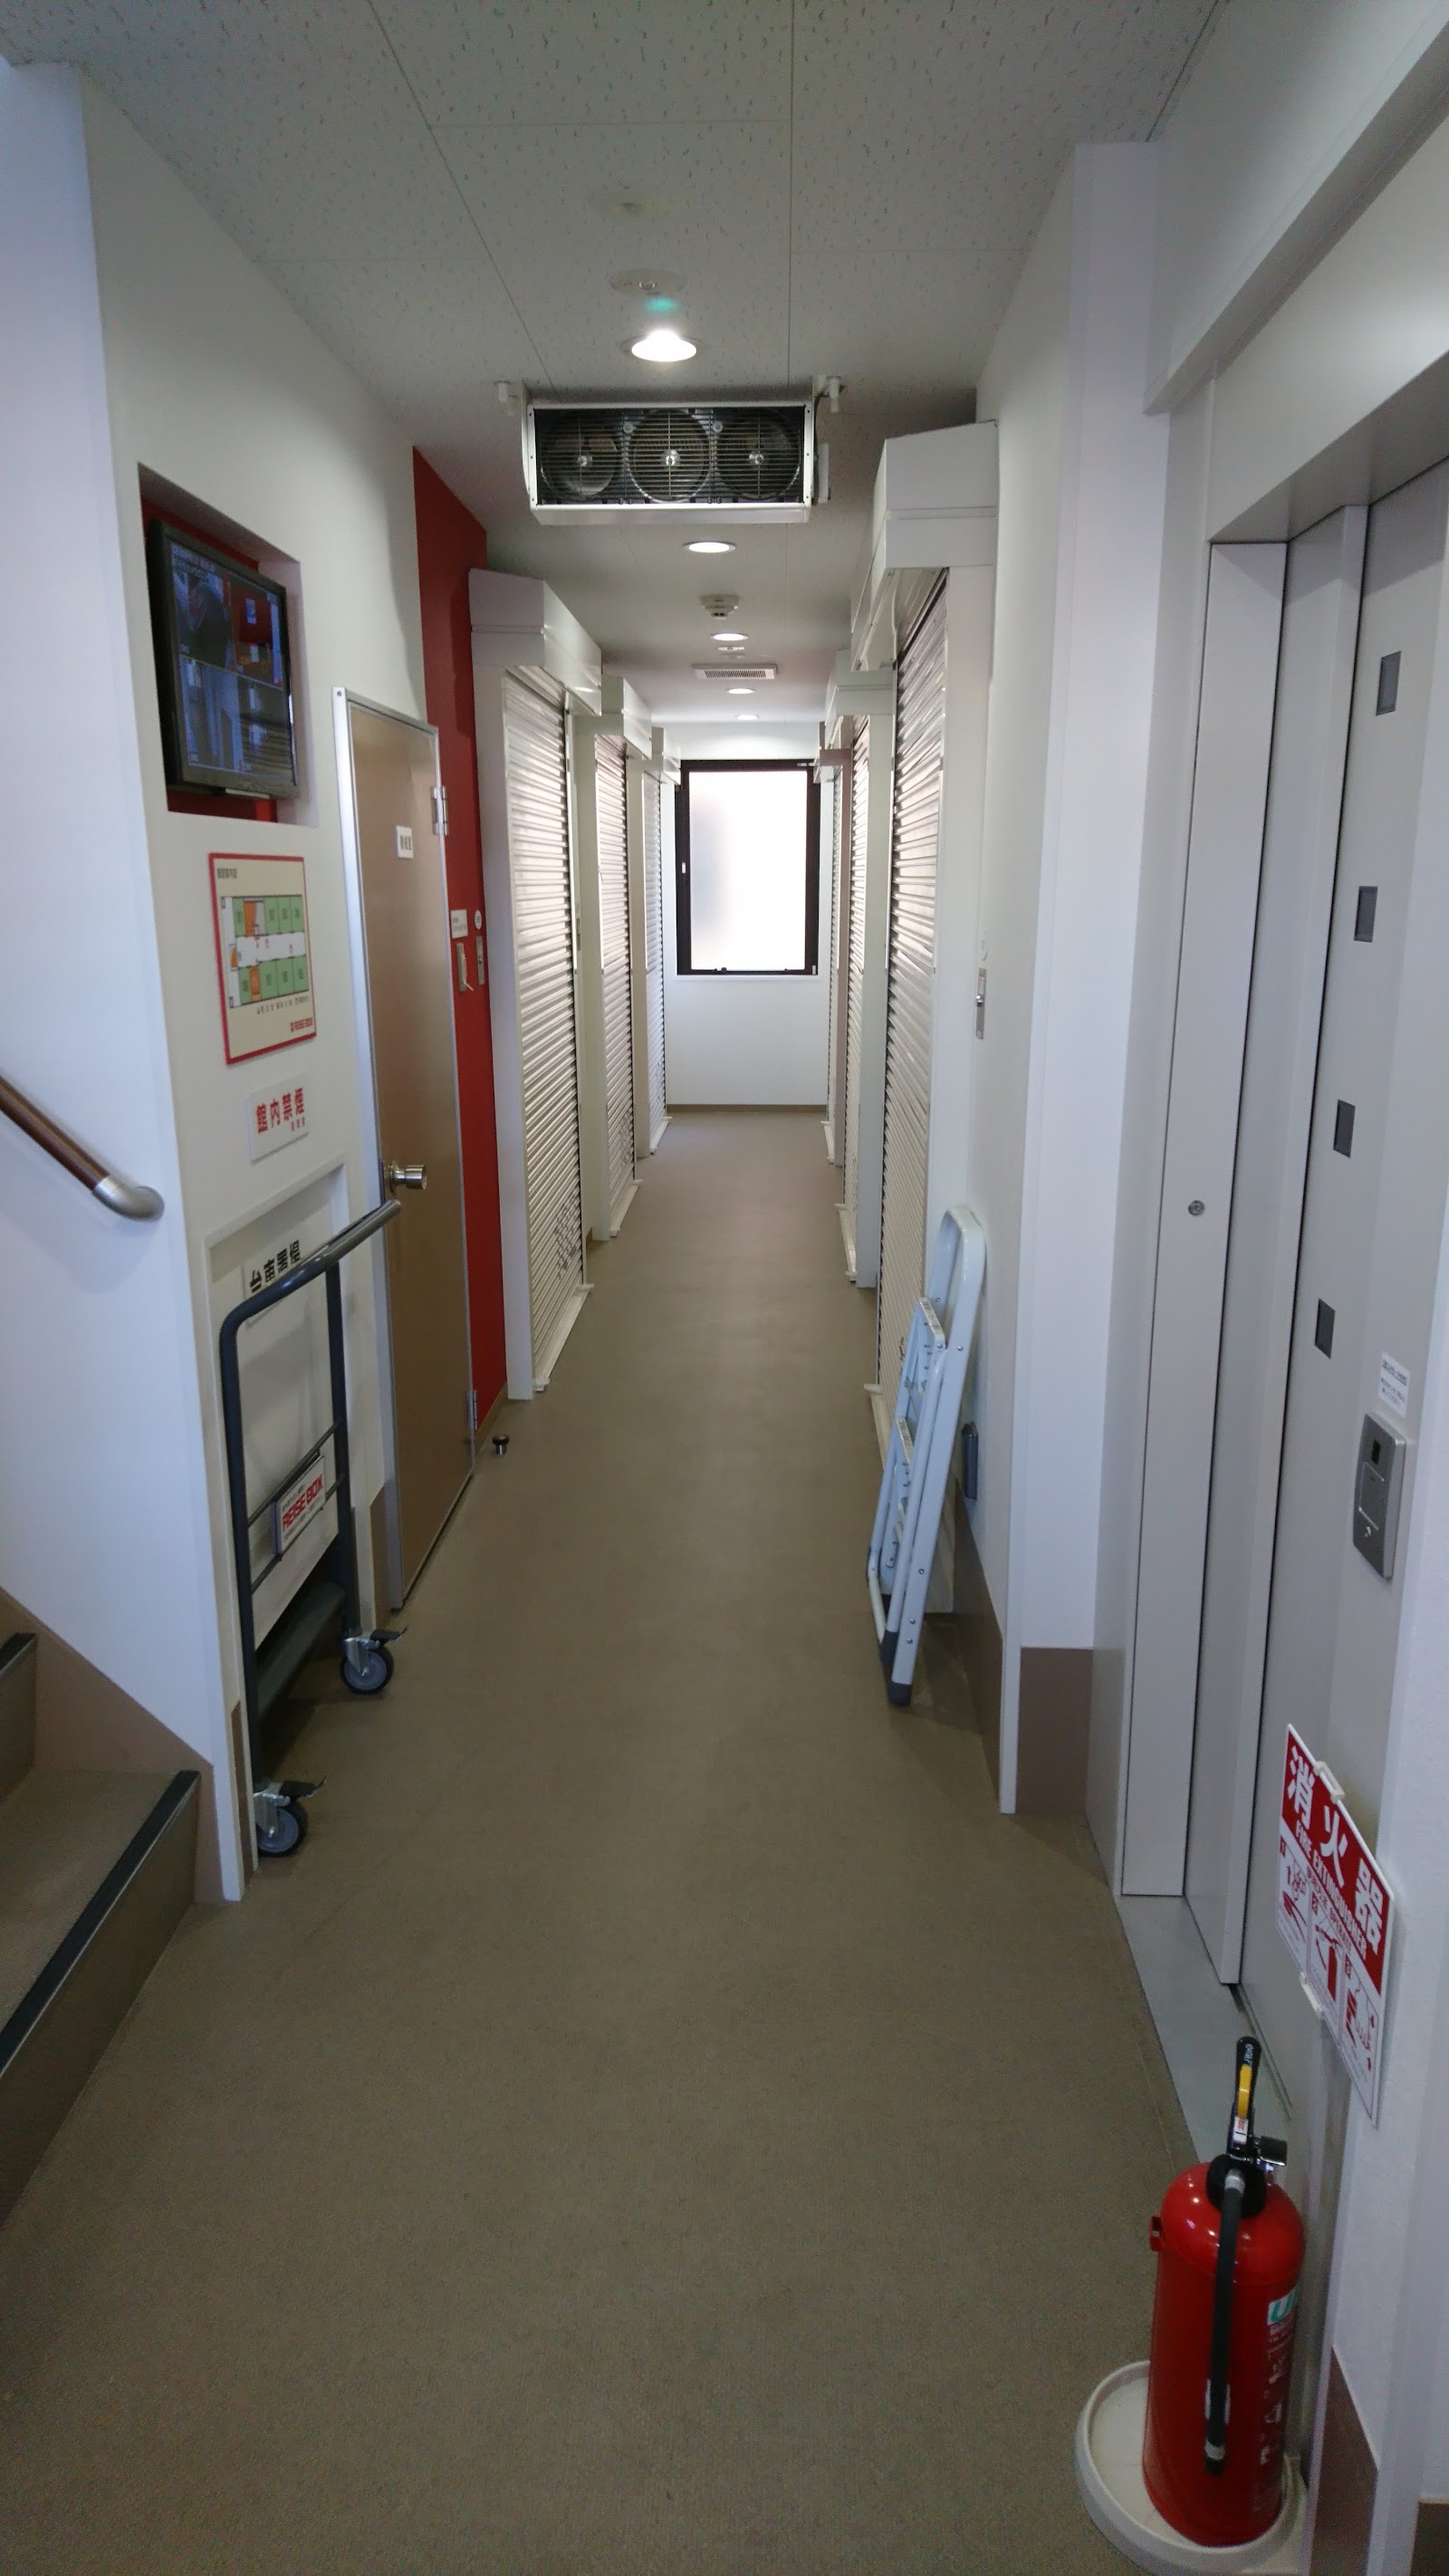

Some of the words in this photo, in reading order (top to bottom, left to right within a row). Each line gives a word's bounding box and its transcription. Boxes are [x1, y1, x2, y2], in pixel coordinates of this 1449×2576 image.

[250, 1239, 301, 1293] 台車置場
[283, 1492, 306, 1533] REISE
[306, 1474, 323, 1505] BOX
[1287, 1745, 1384, 1956] 消火器
[1295, 1819, 1313, 1860] FIRE
[1312, 1849, 1367, 1962] EXTINGUISHER
